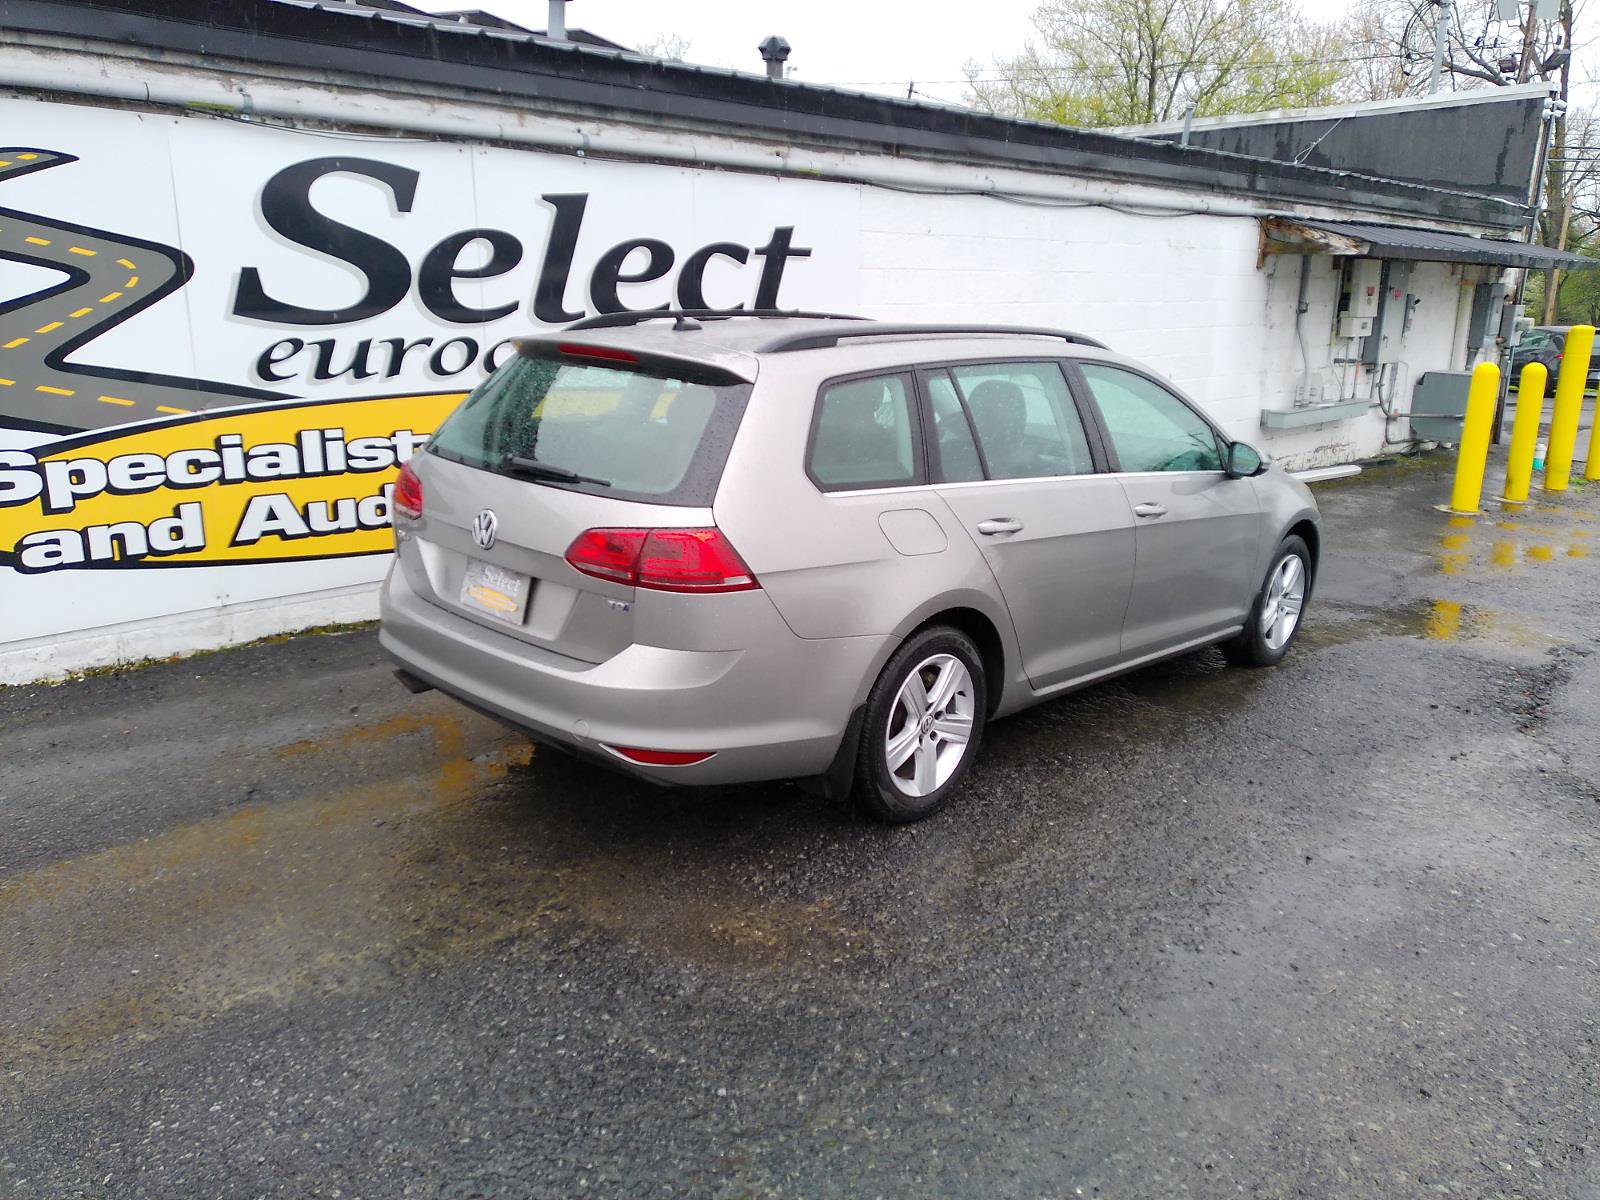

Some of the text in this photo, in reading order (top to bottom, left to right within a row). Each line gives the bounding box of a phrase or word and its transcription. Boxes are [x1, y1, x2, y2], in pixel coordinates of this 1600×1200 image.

[231, 156, 813, 326] Select
[19, 501, 206, 571] and
[483, 565, 521, 594] Select
